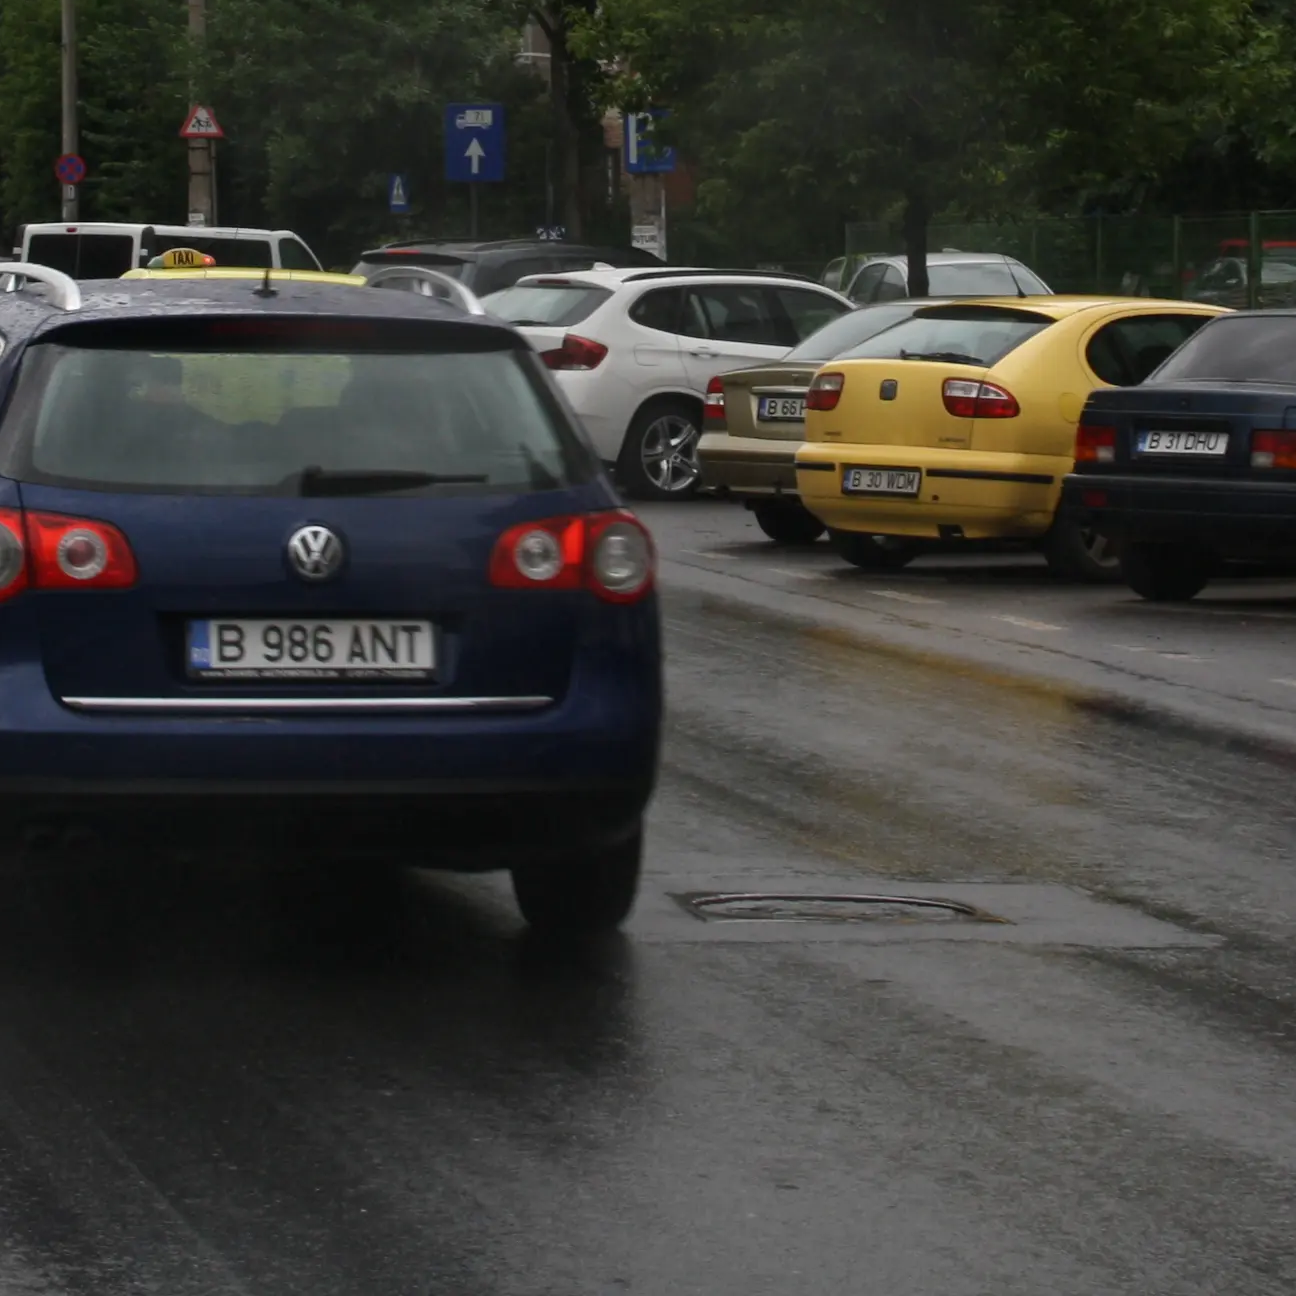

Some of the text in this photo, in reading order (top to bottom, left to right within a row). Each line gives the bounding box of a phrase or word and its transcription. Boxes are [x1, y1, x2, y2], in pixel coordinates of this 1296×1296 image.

[172, 251, 194, 266] TAXI
[768, 400, 777, 415] B
[782, 400, 797, 415] 66
[1148, 432, 1220, 451] B 31 DHU
[852, 471, 917, 490] B 30 WDM
[218, 623, 423, 664] B 986 ANT
